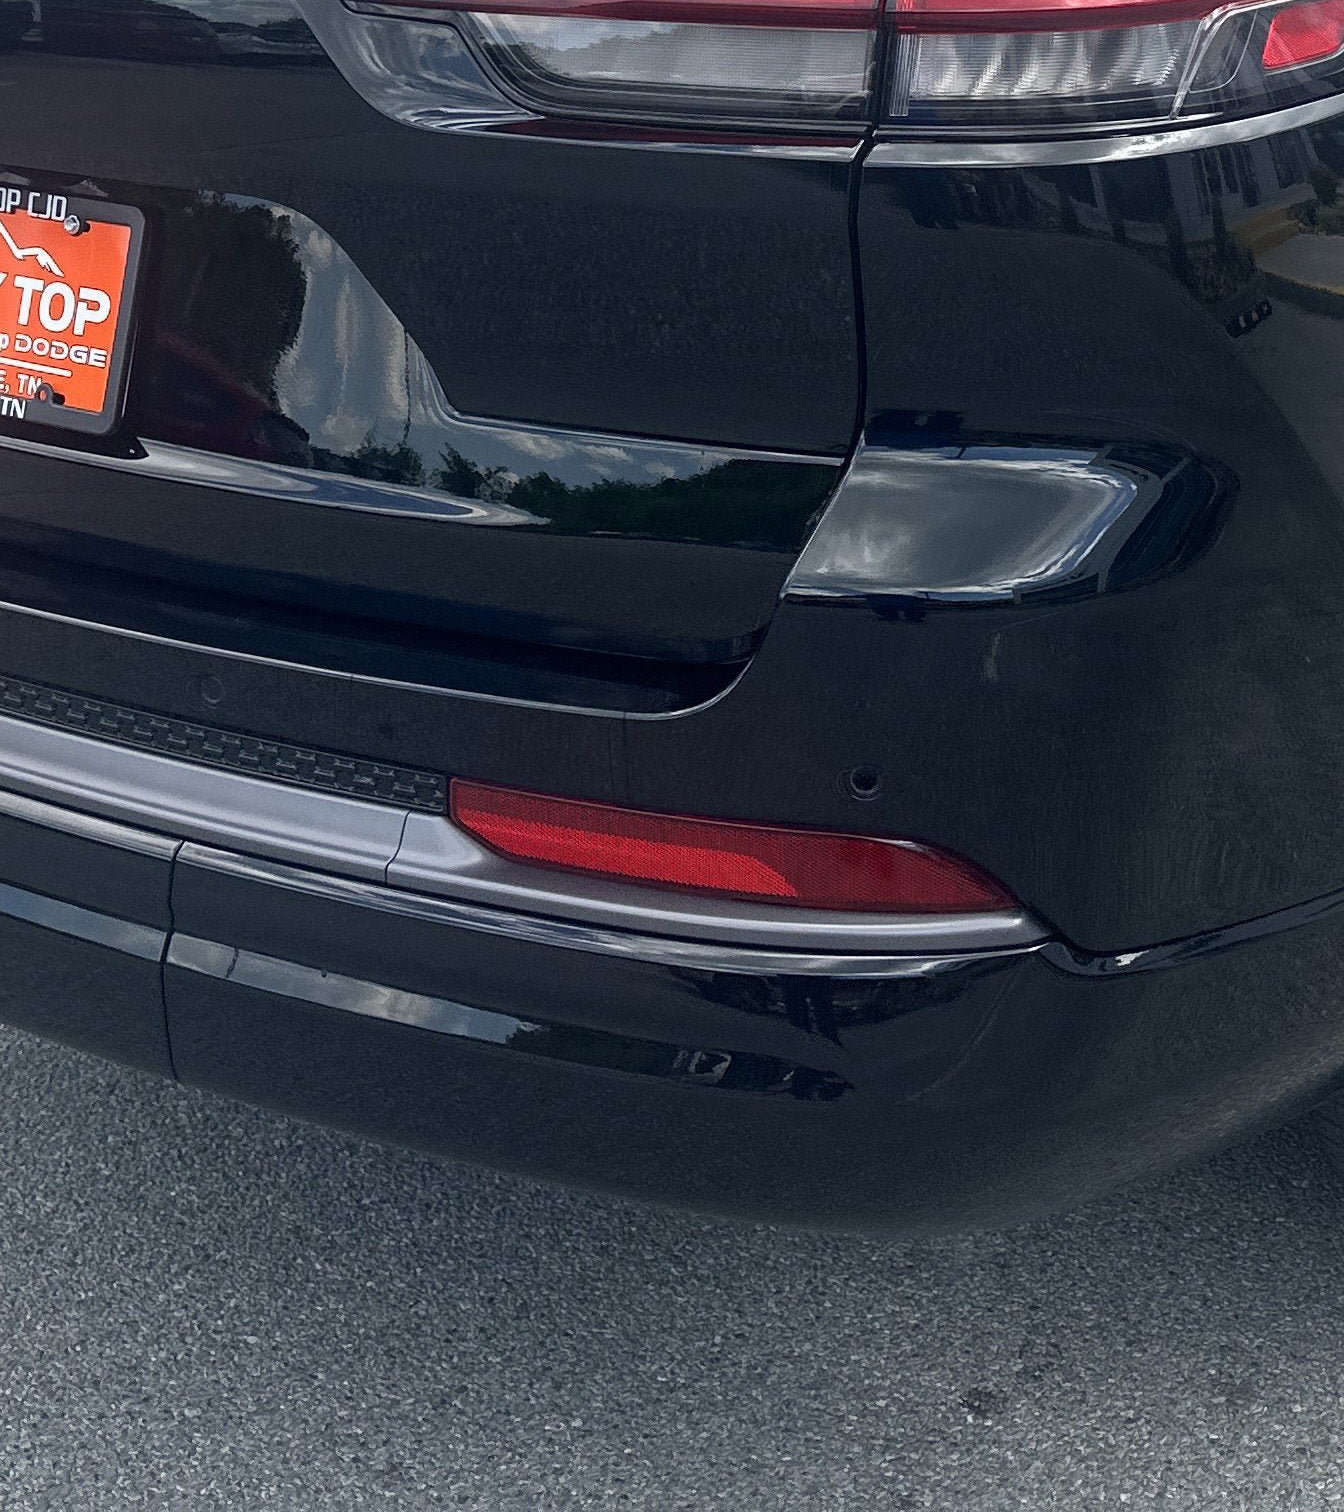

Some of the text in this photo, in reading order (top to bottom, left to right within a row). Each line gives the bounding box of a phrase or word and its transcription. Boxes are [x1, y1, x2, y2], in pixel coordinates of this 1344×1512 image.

[28, 192, 68, 223] CJD
[13, 275, 112, 337] TOP
[14, 333, 108, 369] DODGE
[17, 374, 43, 396] TN
[0, 396, 27, 419] TN
